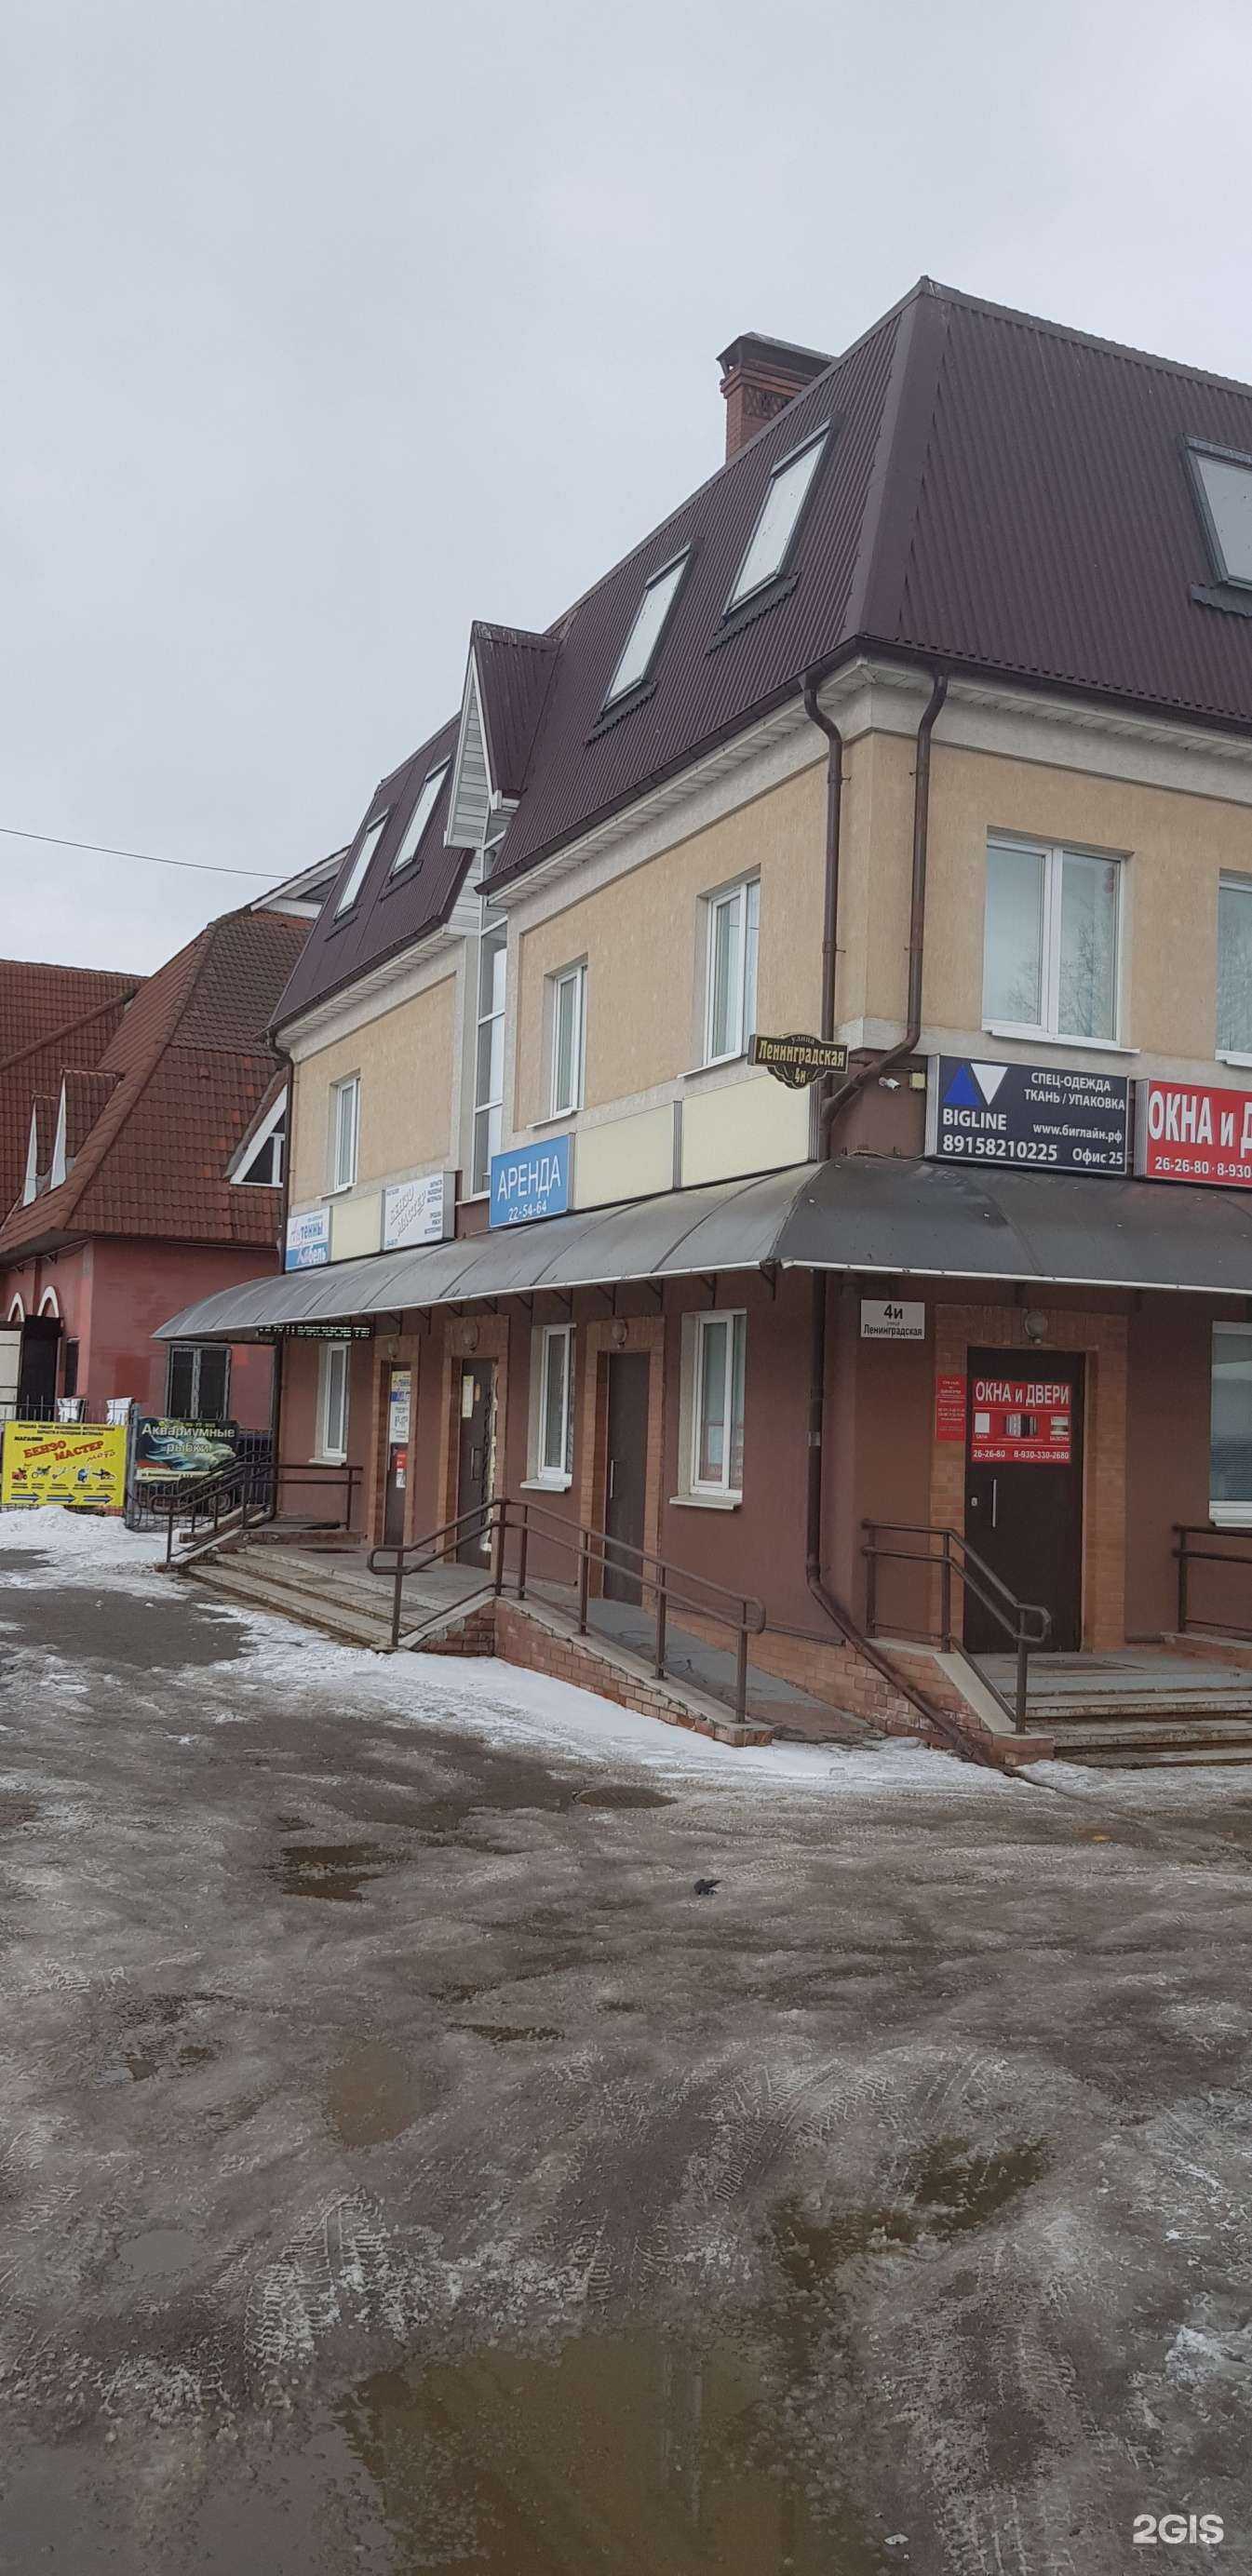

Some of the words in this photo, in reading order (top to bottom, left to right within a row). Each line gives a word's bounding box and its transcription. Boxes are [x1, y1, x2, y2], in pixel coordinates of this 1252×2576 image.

[759, 1040, 844, 1067] Ленинградская
[1030, 1072, 1111, 1093] СПЕЦ-ОДЕЖДА
[1024, 1089, 1060, 1105] ТКАНЬ
[1069, 1093, 1125, 1110] УПАКОВКА
[943, 1108, 1007, 1131] BIGLINE
[1148, 1091, 1213, 1145] ОКНА
[1220, 1111, 1234, 1147] и
[1033, 1123, 1123, 1144] www.биглайн.рф
[943, 1134, 1057, 1161] 89158210225
[1072, 1147, 1107, 1164] Офис
[1109, 1151, 1124, 1164] 25
[1155, 1156, 1209, 1174] 26-26-80
[497, 1155, 561, 1201] АРЕНДА
[508, 1200, 547, 1221] 22-54-64
[883, 1304, 903, 1320] 4и
[864, 1324, 922, 1337] Ленинградская
[976, 1381, 1012, 1402] ОКНА
[1015, 1388, 1023, 1403] и
[1025, 1384, 1070, 1407] ДВЕРИ
[141, 1423, 236, 1439] Аквариумные
[55, 1441, 104, 1461] МАСТЕР
[974, 1450, 1005, 1458] 26-26-80
[1014, 1450, 1070, 1460] 8-930-330-2680
